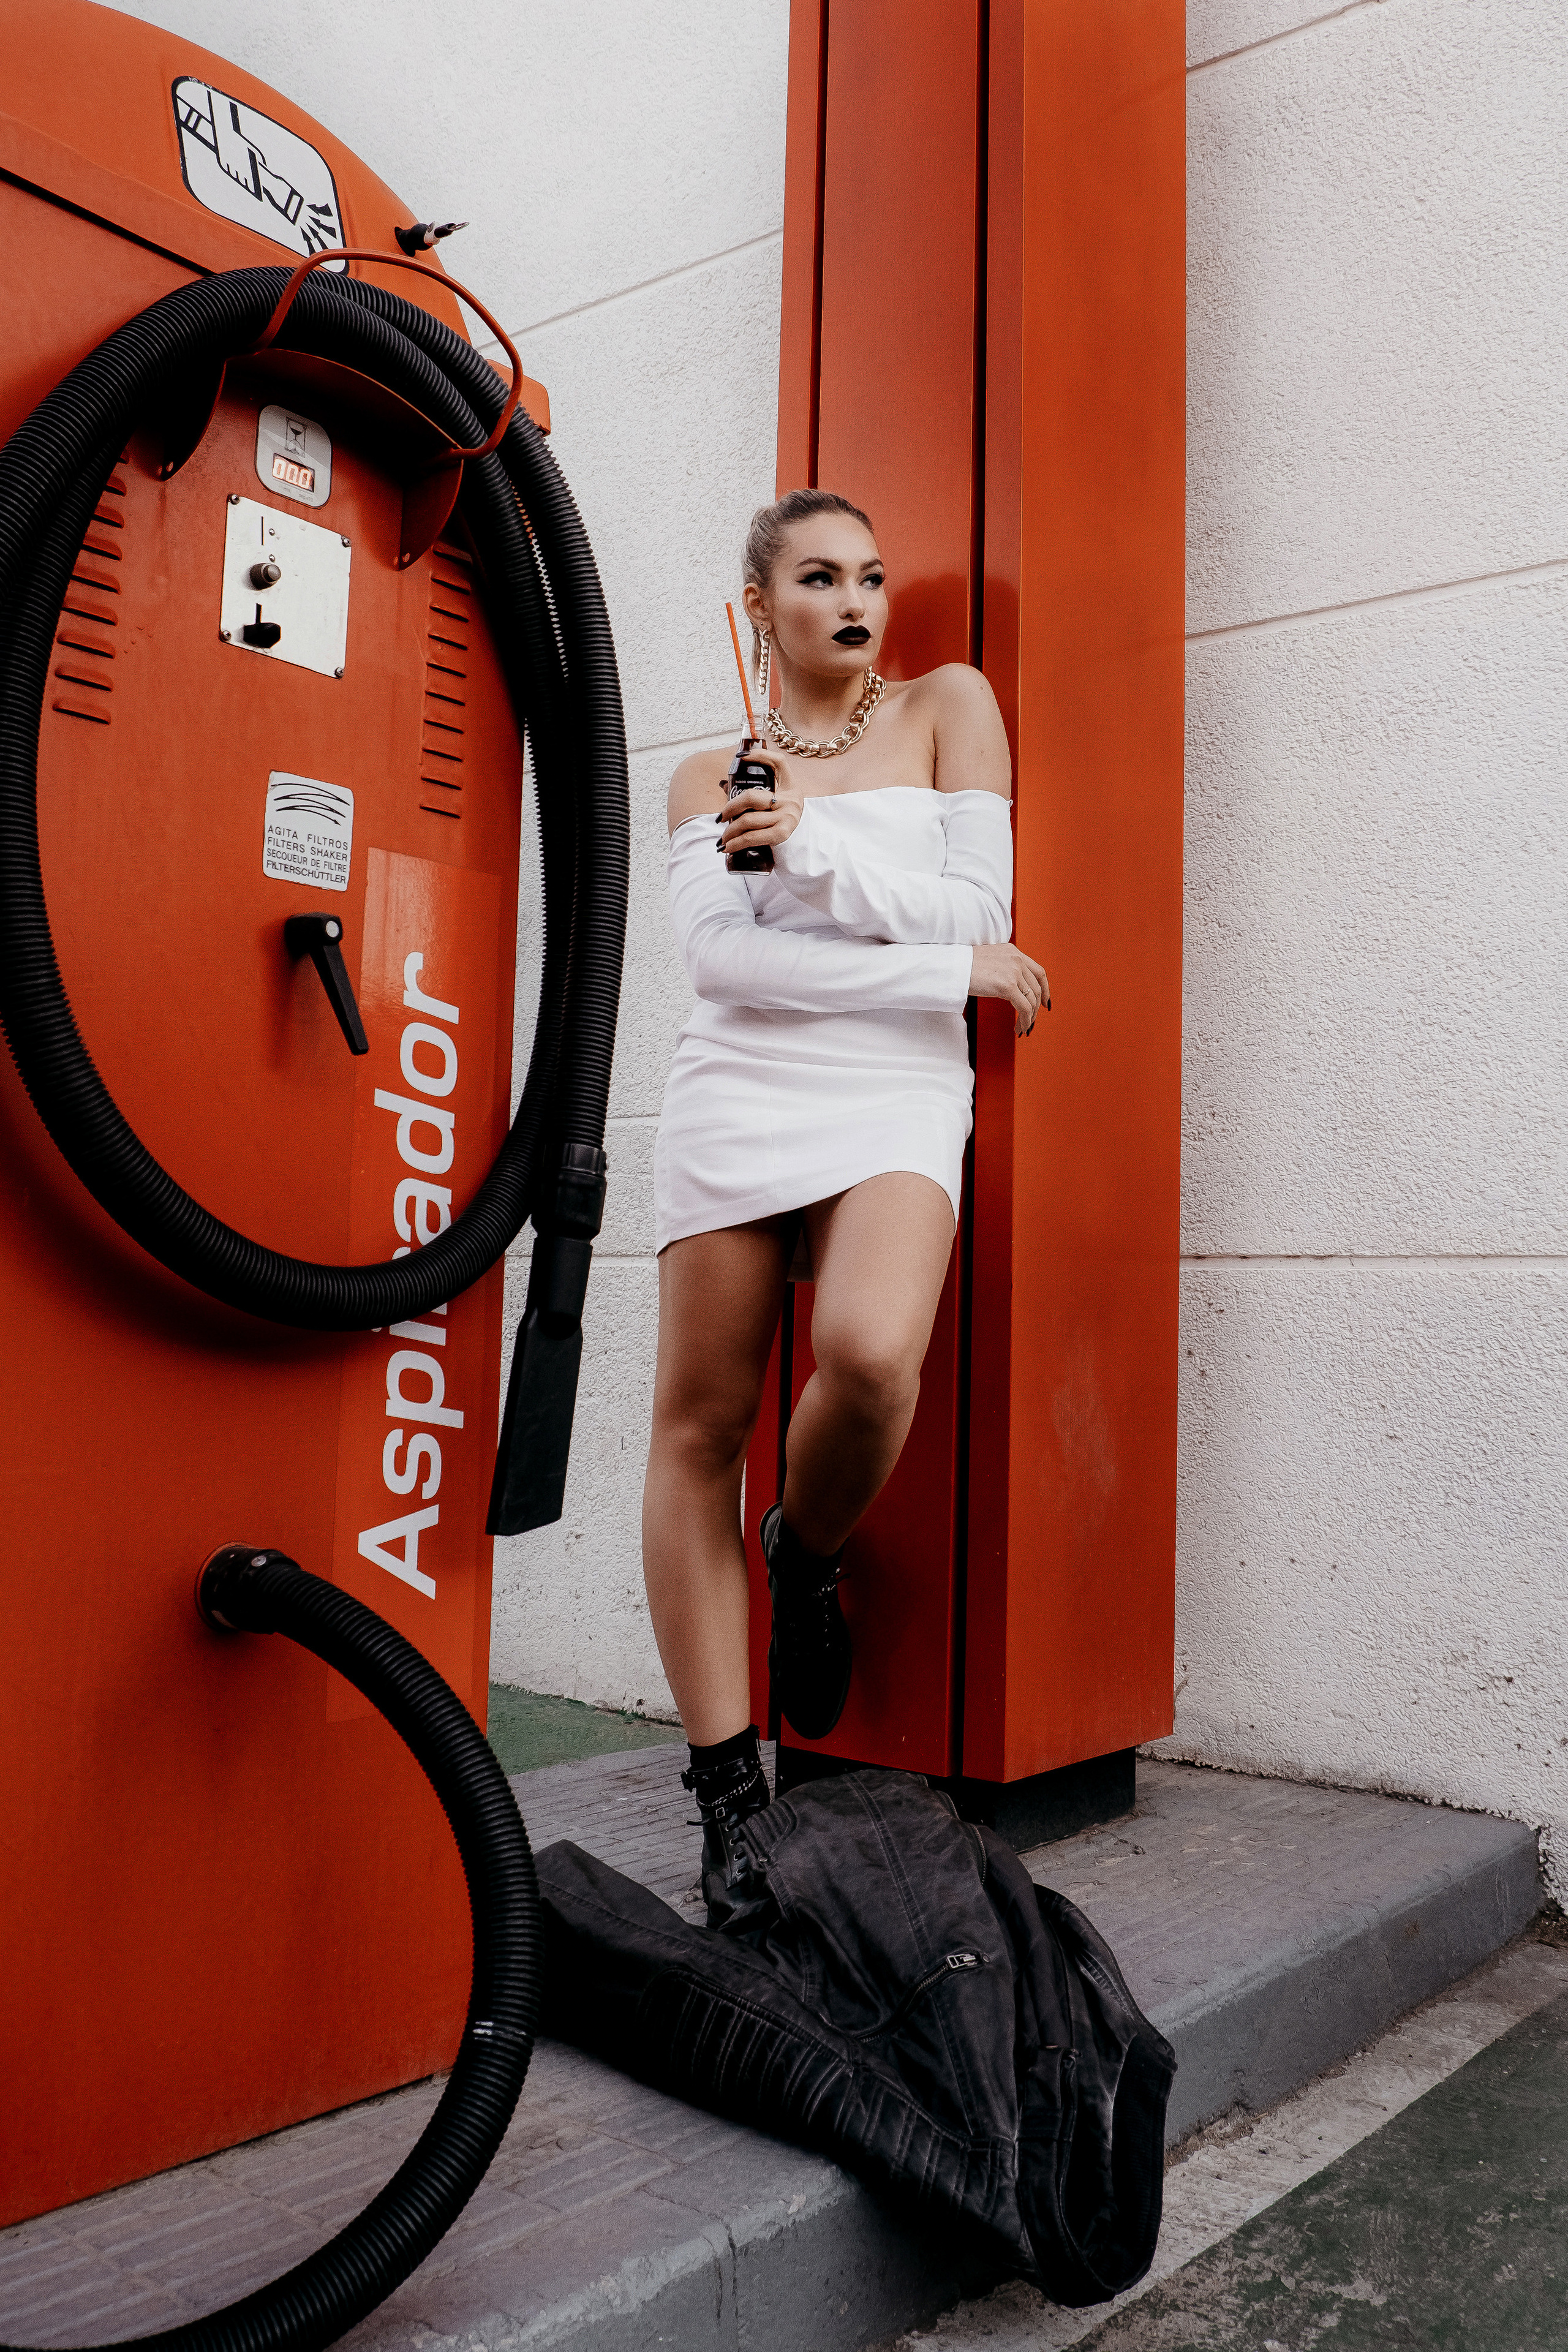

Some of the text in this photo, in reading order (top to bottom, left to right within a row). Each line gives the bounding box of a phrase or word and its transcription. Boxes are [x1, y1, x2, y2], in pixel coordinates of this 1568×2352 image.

[267, 837, 347, 862] FILTERS SHAKER
[268, 825, 348, 850] AGITA FILTROS
[266, 848, 347, 873] SECOUEUR DE FILTRE
[266, 860, 346, 884] FILTERSCHÜTTLER
[358, 951, 464, 1600] Aspiador
